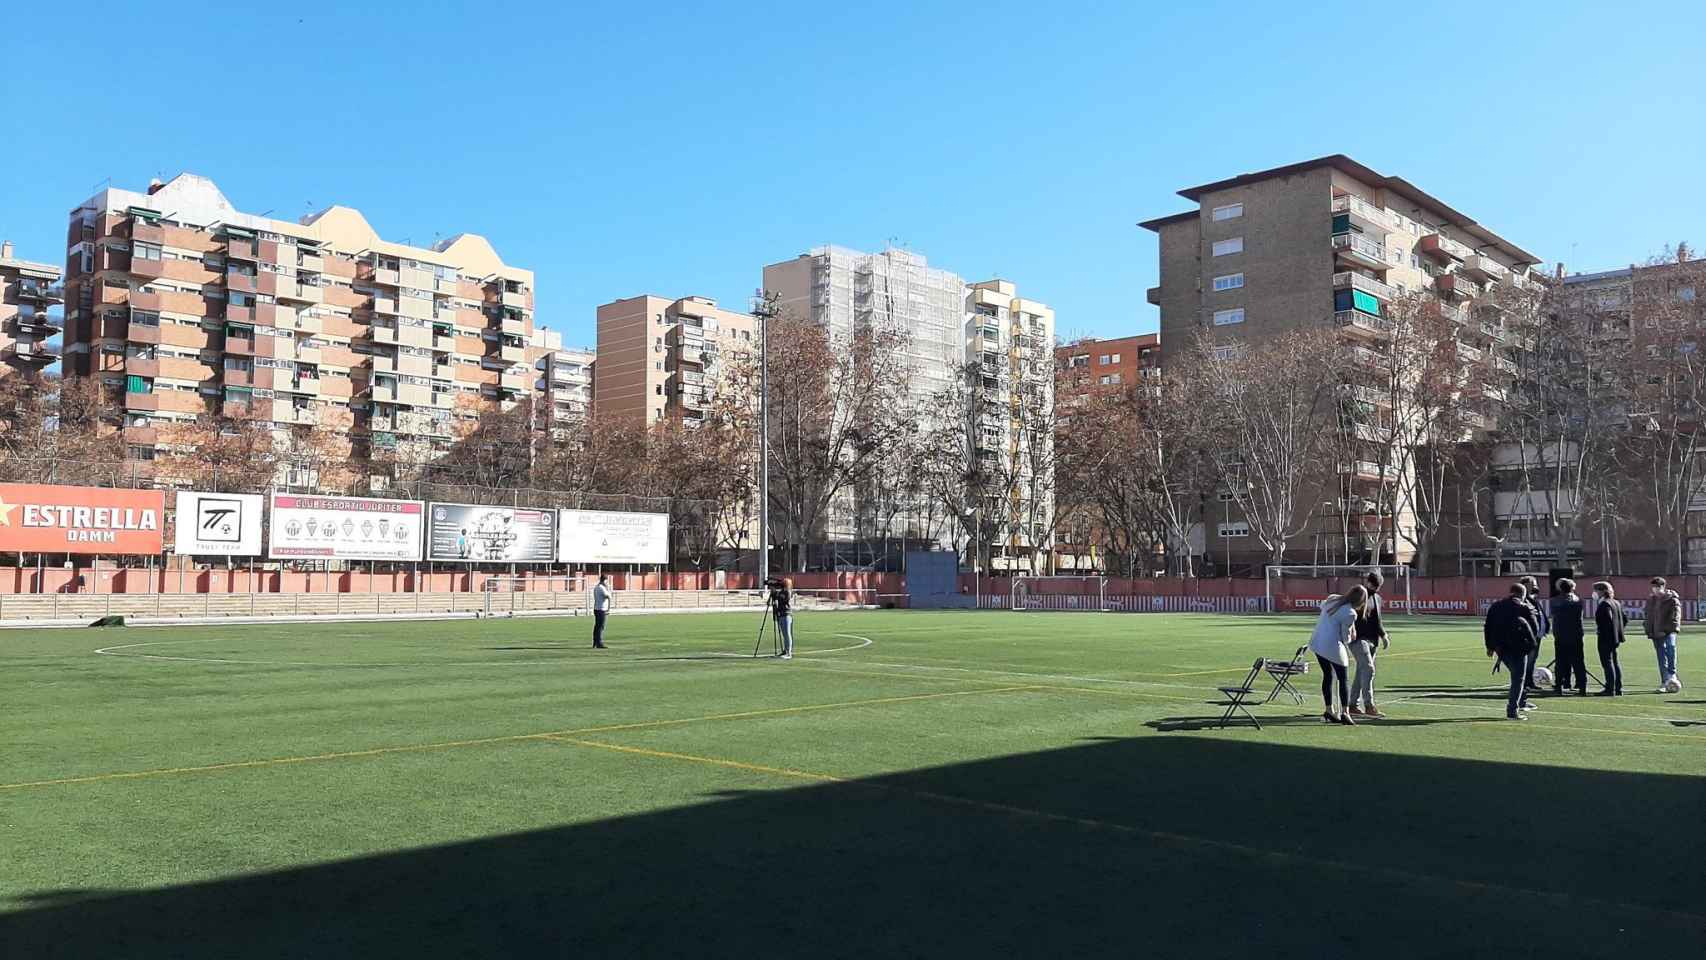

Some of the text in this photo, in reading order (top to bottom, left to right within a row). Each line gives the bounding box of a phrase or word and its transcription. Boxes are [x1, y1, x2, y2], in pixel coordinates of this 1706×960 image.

[296, 499, 319, 508] CLUB
[23, 503, 157, 530] ESTRELLA
[67, 530, 114, 542] DAMM
[1389, 600, 1468, 609] ESTRELLA DAMM
